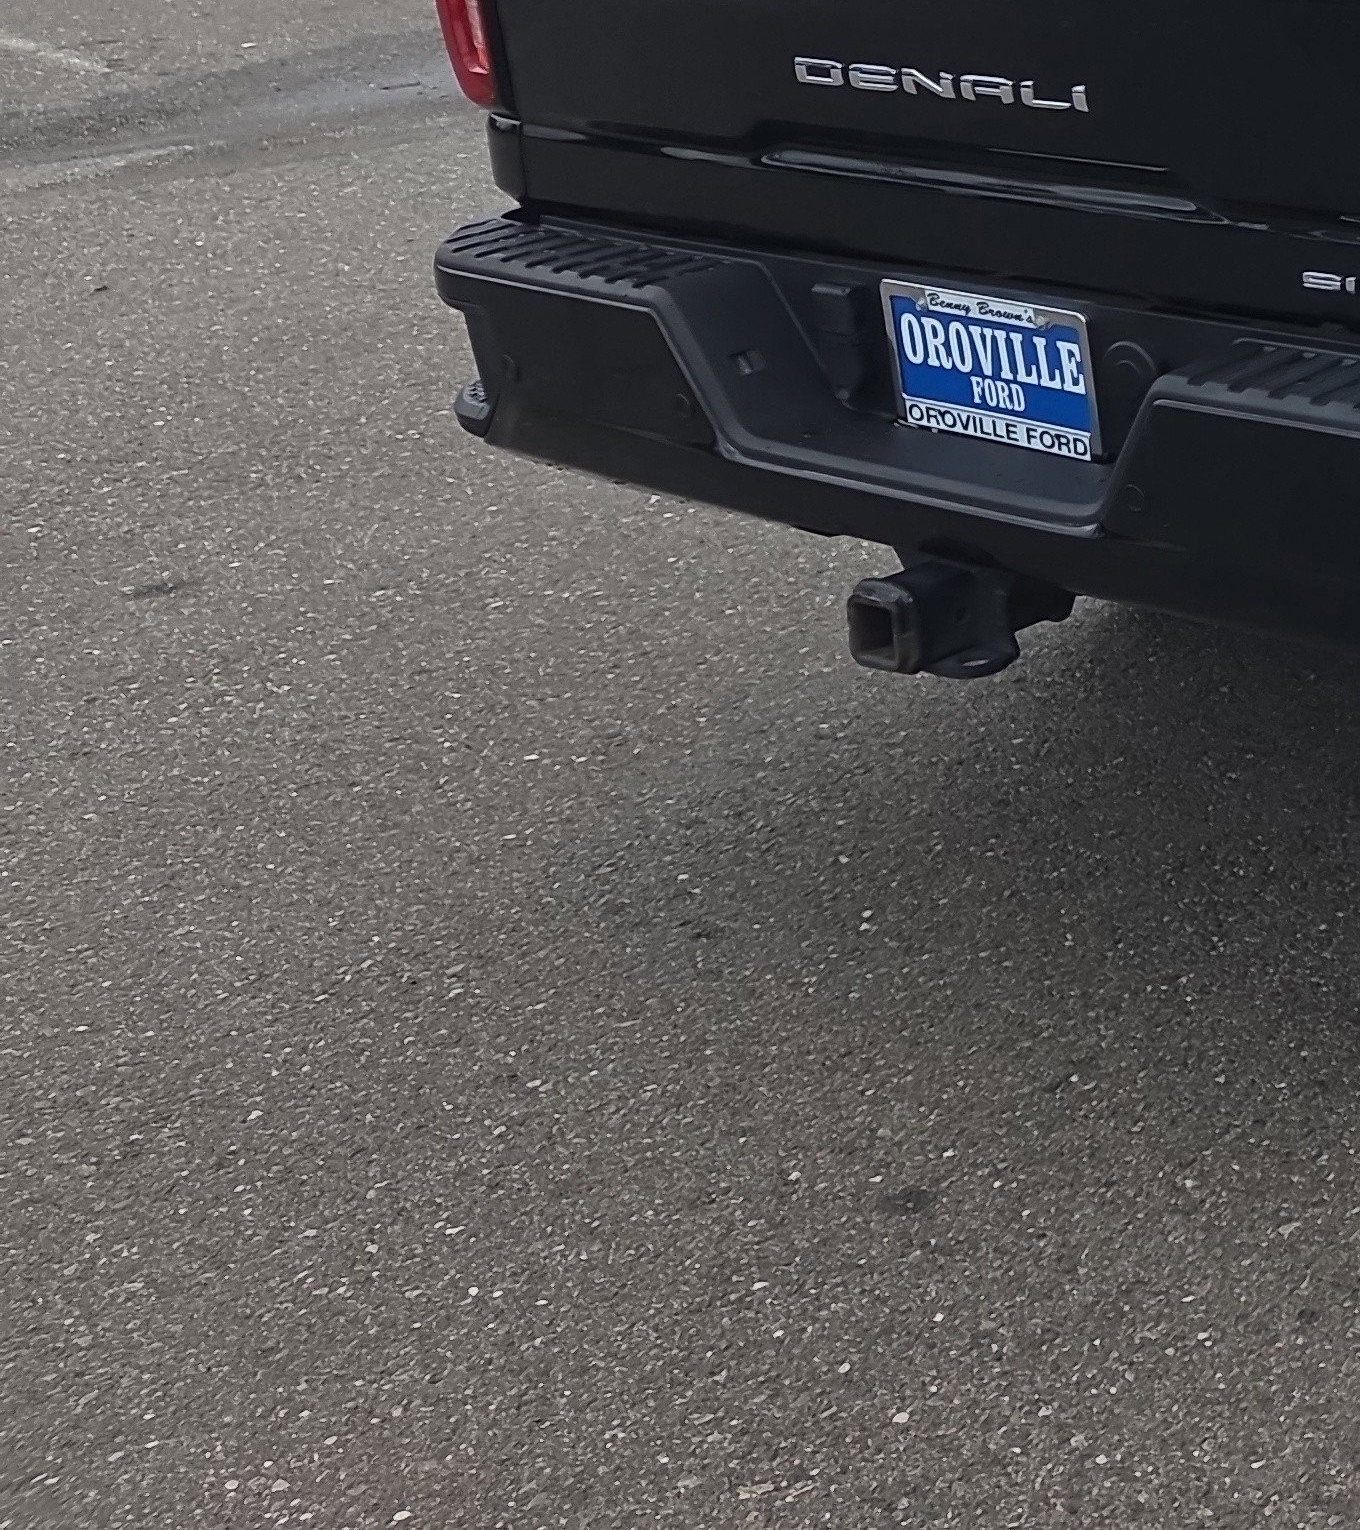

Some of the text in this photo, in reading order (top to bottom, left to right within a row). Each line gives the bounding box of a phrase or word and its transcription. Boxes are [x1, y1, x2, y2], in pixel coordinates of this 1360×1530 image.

[794, 56, 1089, 113] DENALI
[926, 292, 1034, 324] Benny Brown's
[900, 311, 1087, 395] OROVILLE
[969, 375, 1026, 412] FORD
[908, 403, 1089, 457] OROVILLE FORD
